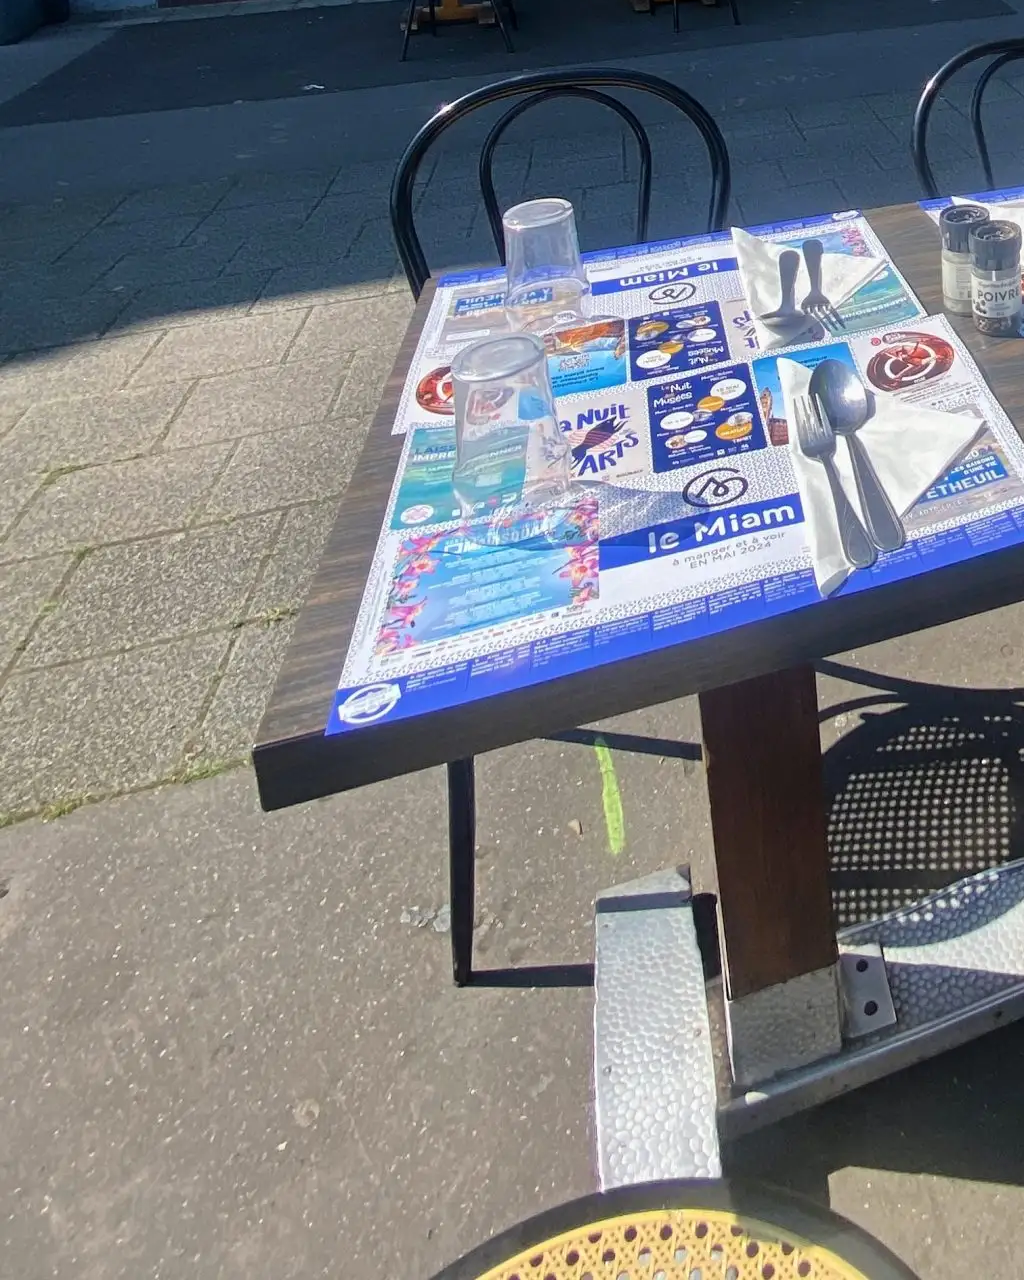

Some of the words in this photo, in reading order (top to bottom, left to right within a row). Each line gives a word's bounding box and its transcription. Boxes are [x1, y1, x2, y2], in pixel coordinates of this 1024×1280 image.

[620, 269, 689, 287] Miam
[699, 261, 718, 272] le
[653, 391, 693, 408] Musées
[670, 382, 692, 393] Nuit
[577, 404, 630, 430] Nuit
[578, 432, 640, 477] ARTS
[648, 532, 680, 554] le
[694, 505, 796, 542] Miam
[684, 544, 732, 564] manger
[735, 538, 748, 549] et
[763, 531, 786, 541] voir
[690, 559, 708, 570] EN
[712, 551, 736, 563] MAI
[740, 542, 772, 555] 2024
